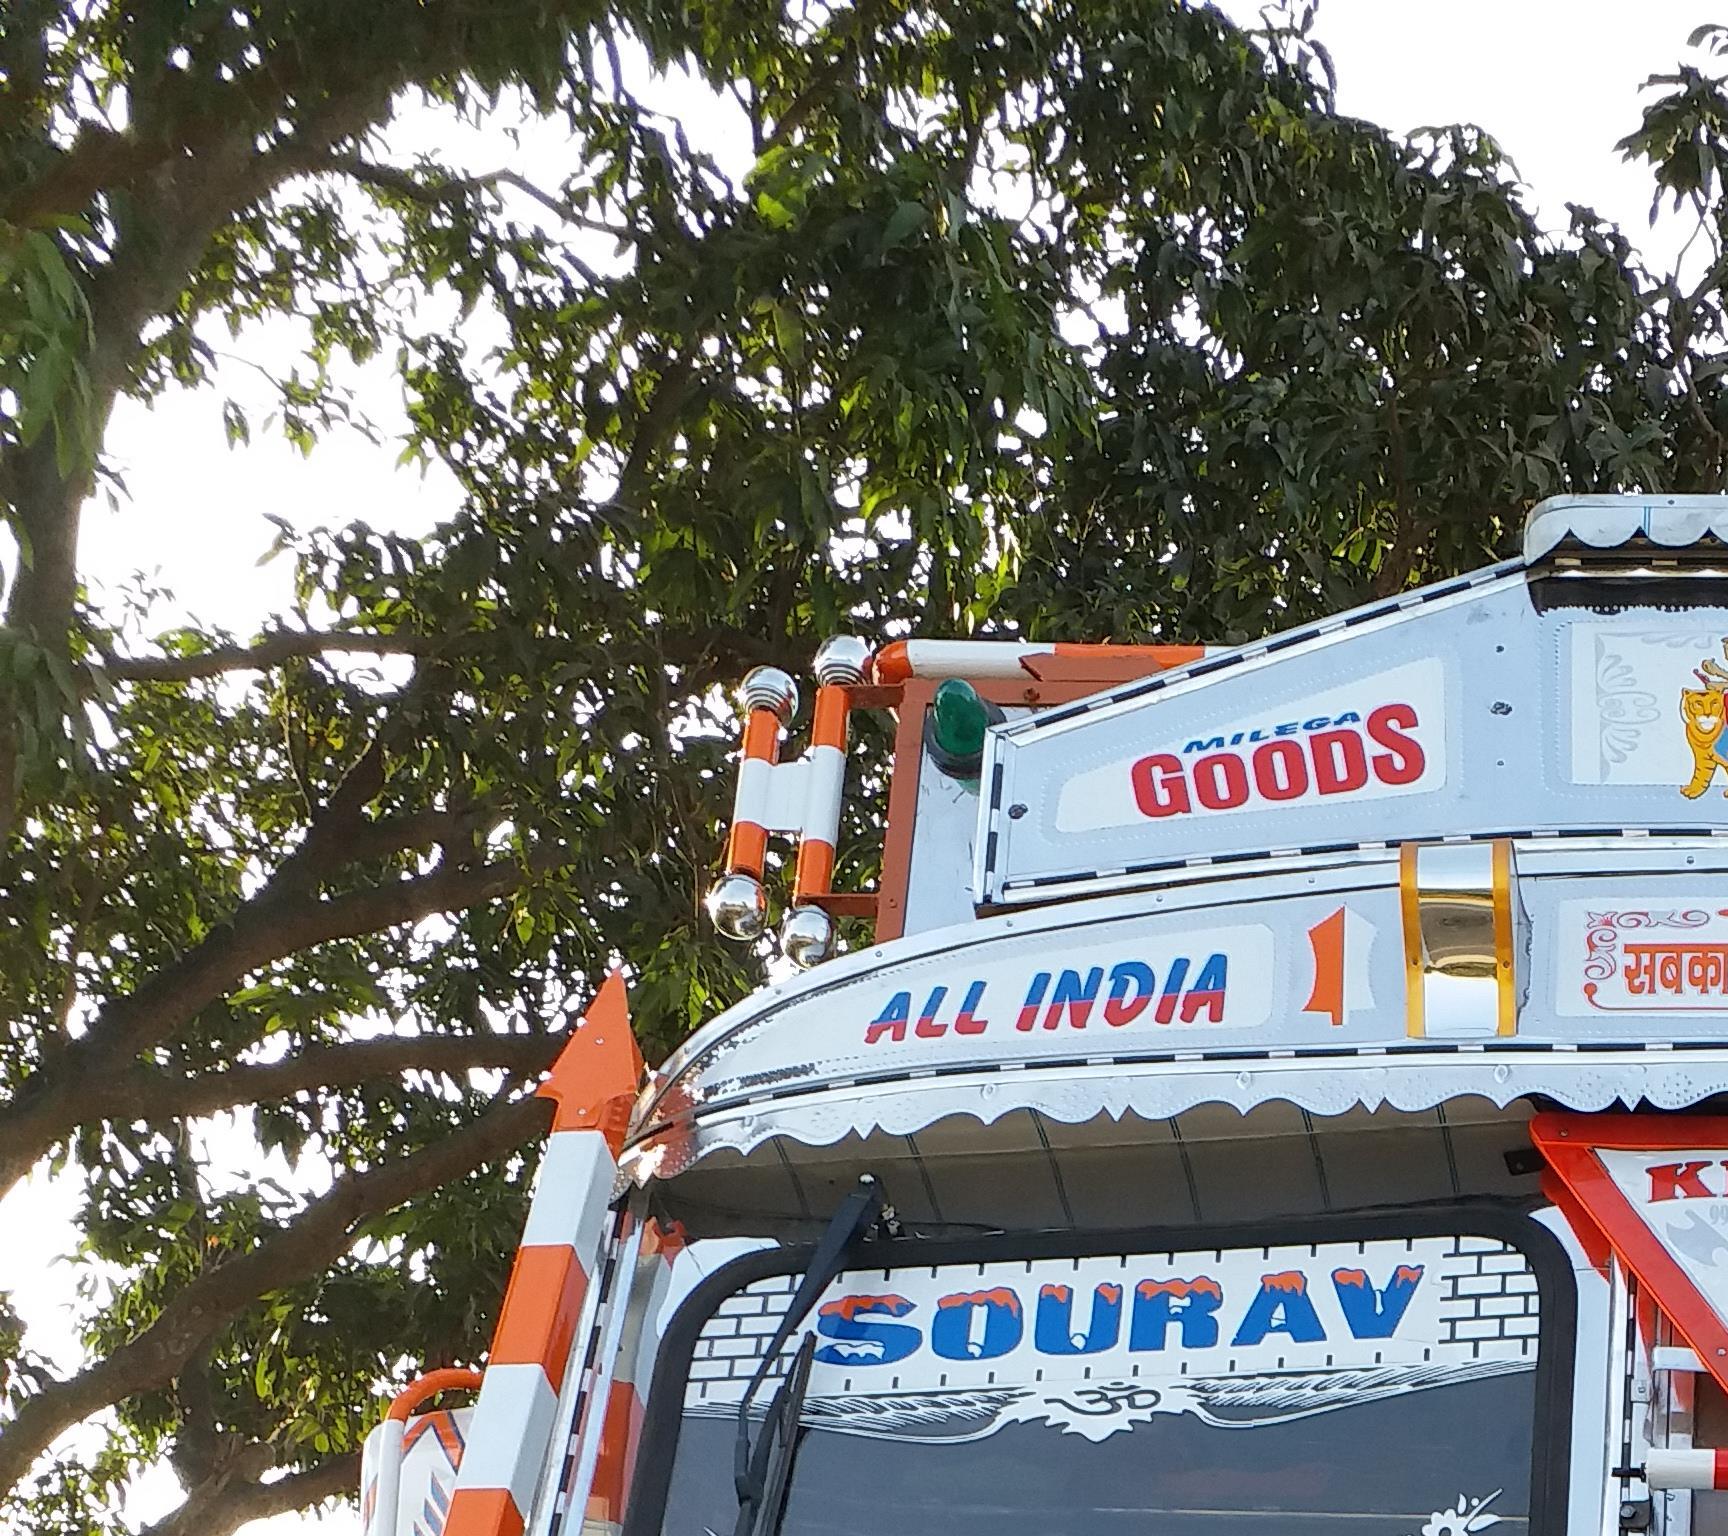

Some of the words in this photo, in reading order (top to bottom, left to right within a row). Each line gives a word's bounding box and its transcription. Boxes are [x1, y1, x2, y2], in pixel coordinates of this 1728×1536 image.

[1131, 703, 1426, 818] GOODS
[1184, 712, 1360, 753] MILEGA
[865, 980, 989, 1044] ALL
[1015, 954, 1227, 1032] INDIA
[815, 1265, 1425, 1367] SOURAV
